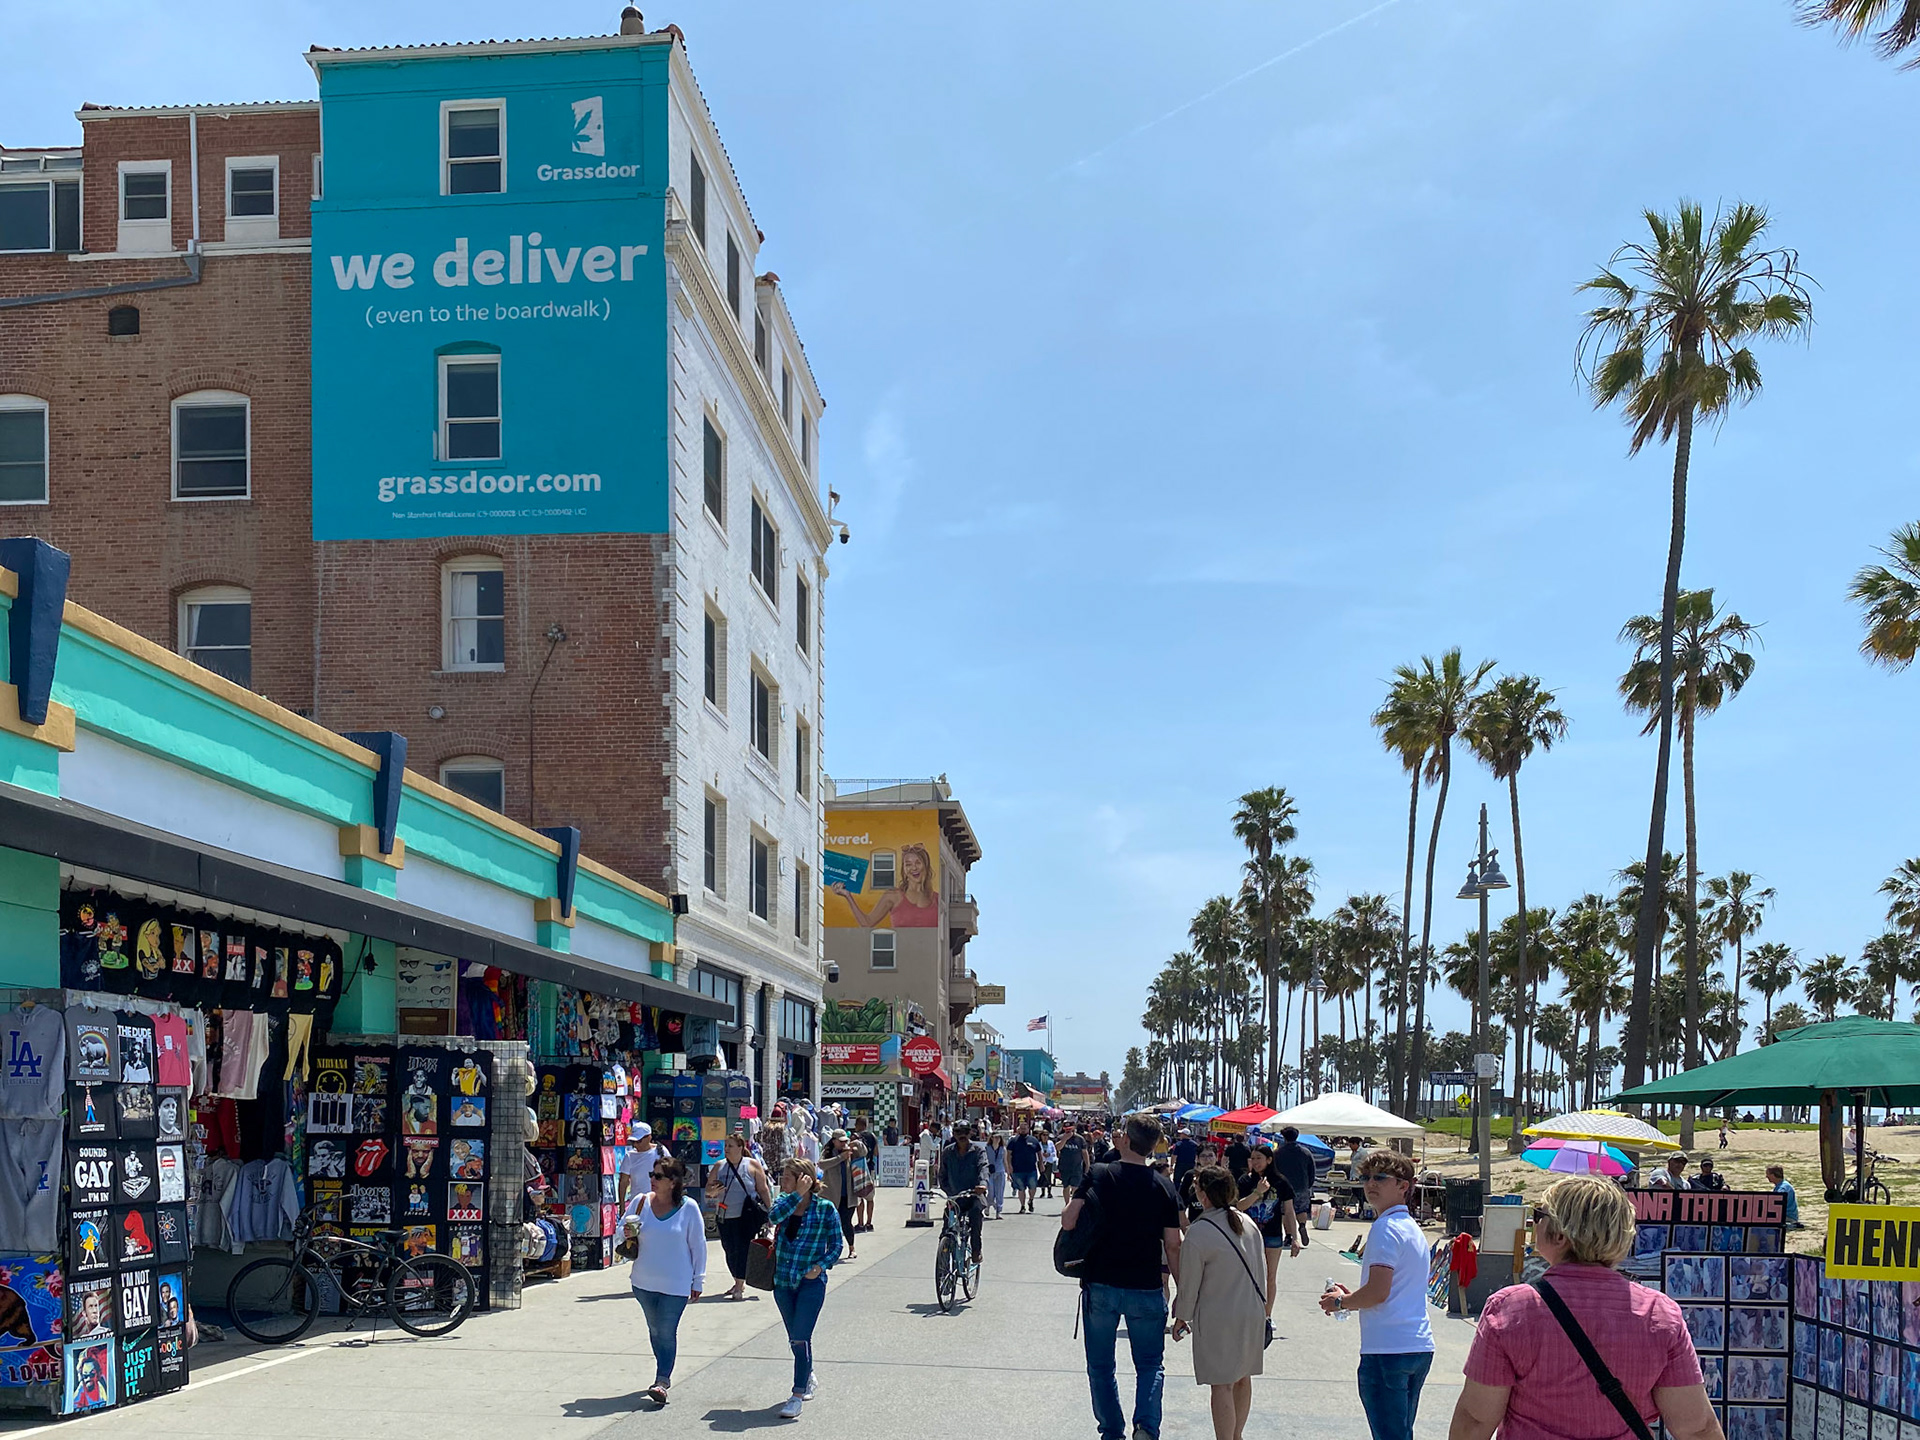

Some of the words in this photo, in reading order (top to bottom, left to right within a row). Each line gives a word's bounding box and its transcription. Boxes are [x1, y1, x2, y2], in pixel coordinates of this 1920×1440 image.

[537, 162, 640, 181] Grassdoor
[330, 252, 415, 290] we
[433, 232, 648, 287] deliver
[365, 305, 423, 328] (even
[429, 305, 450, 322] to
[455, 303, 489, 321] the
[495, 298, 610, 321] boardwalk)
[377, 470, 601, 503] grassdoor.com
[117, 1025, 132, 1036] THE
[132, 1027, 152, 1038] DUDE
[8, 1030, 43, 1077] LA
[316, 1058, 348, 1069] NIRVANA
[315, 1093, 343, 1101] BLACK
[822, 1087, 860, 1095] SANDWICH
[966, 1091, 998, 1104] TATTOO
[404, 1136, 439, 1146] Supreme
[80, 1148, 107, 1158] SOUNDS
[75, 1161, 114, 1188] GAY
[915, 1180, 926, 1213] ATM
[451, 1208, 479, 1220] XXX
[1678, 1193, 1784, 1223] TATTOOS
[121, 1272, 134, 1287] I'M
[135, 1269, 149, 1285] NOT
[123, 1285, 150, 1320] GAY
[159, 1336, 182, 1357] oogle
[124, 1347, 152, 1367] JUST
[8, 1361, 61, 1382] LOVE
[125, 1364, 145, 1382] HIT
[126, 1381, 139, 1397] IT.
